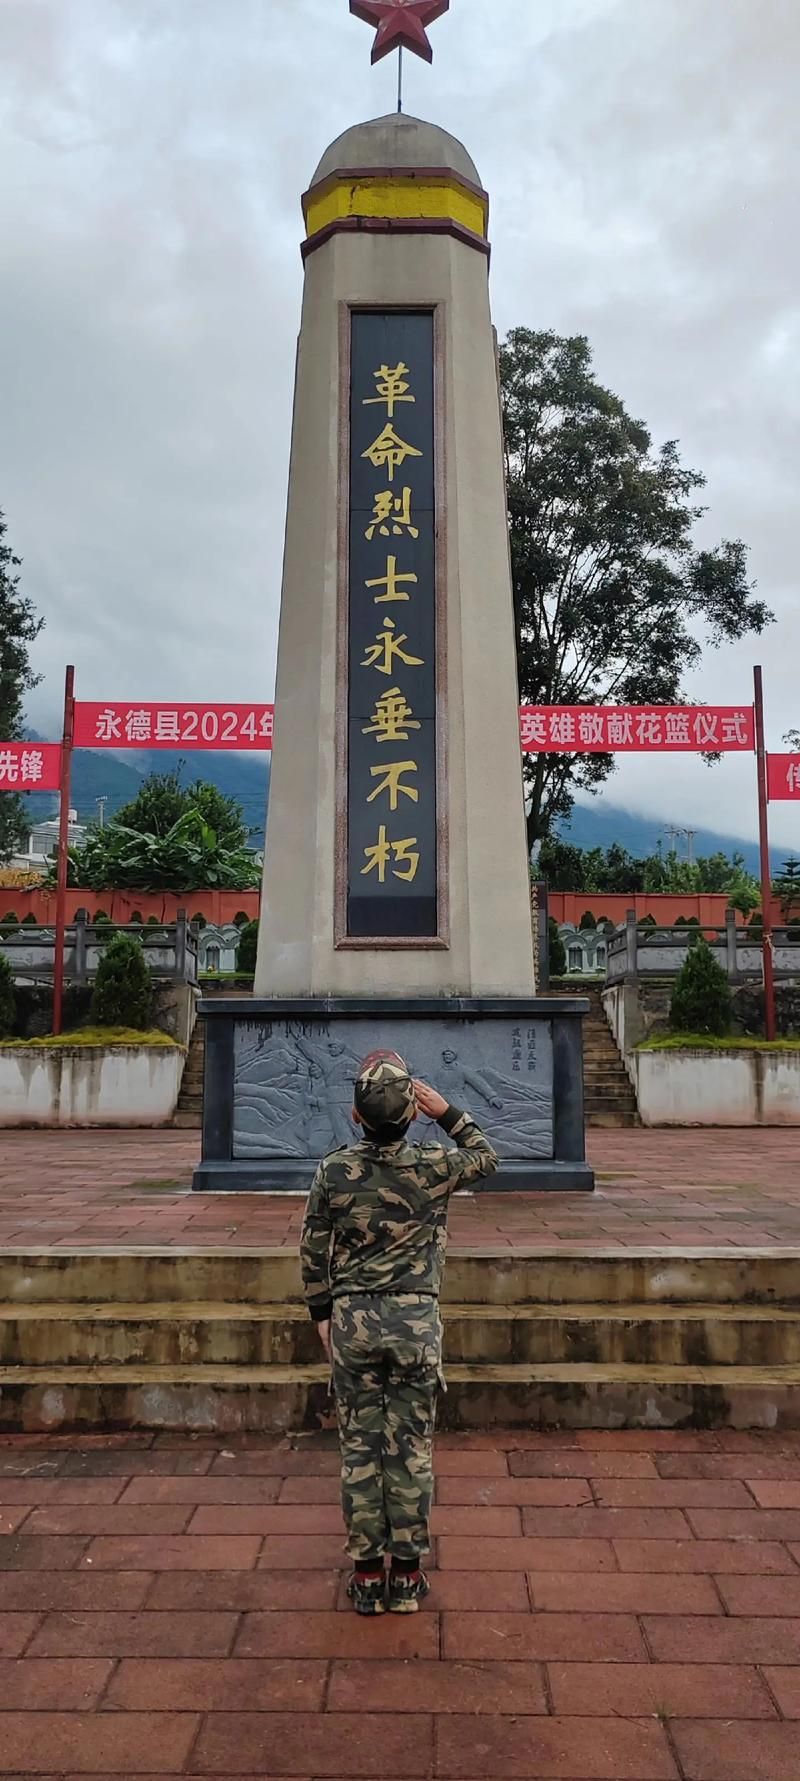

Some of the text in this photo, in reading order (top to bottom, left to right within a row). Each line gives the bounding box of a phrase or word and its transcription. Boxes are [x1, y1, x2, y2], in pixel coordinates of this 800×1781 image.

[360, 363, 425, 883] 革命烈士永垂不朽
[520, 711, 748, 745] 英雄敬献花篮仪式
[0, 750, 43, 783] 先锋
